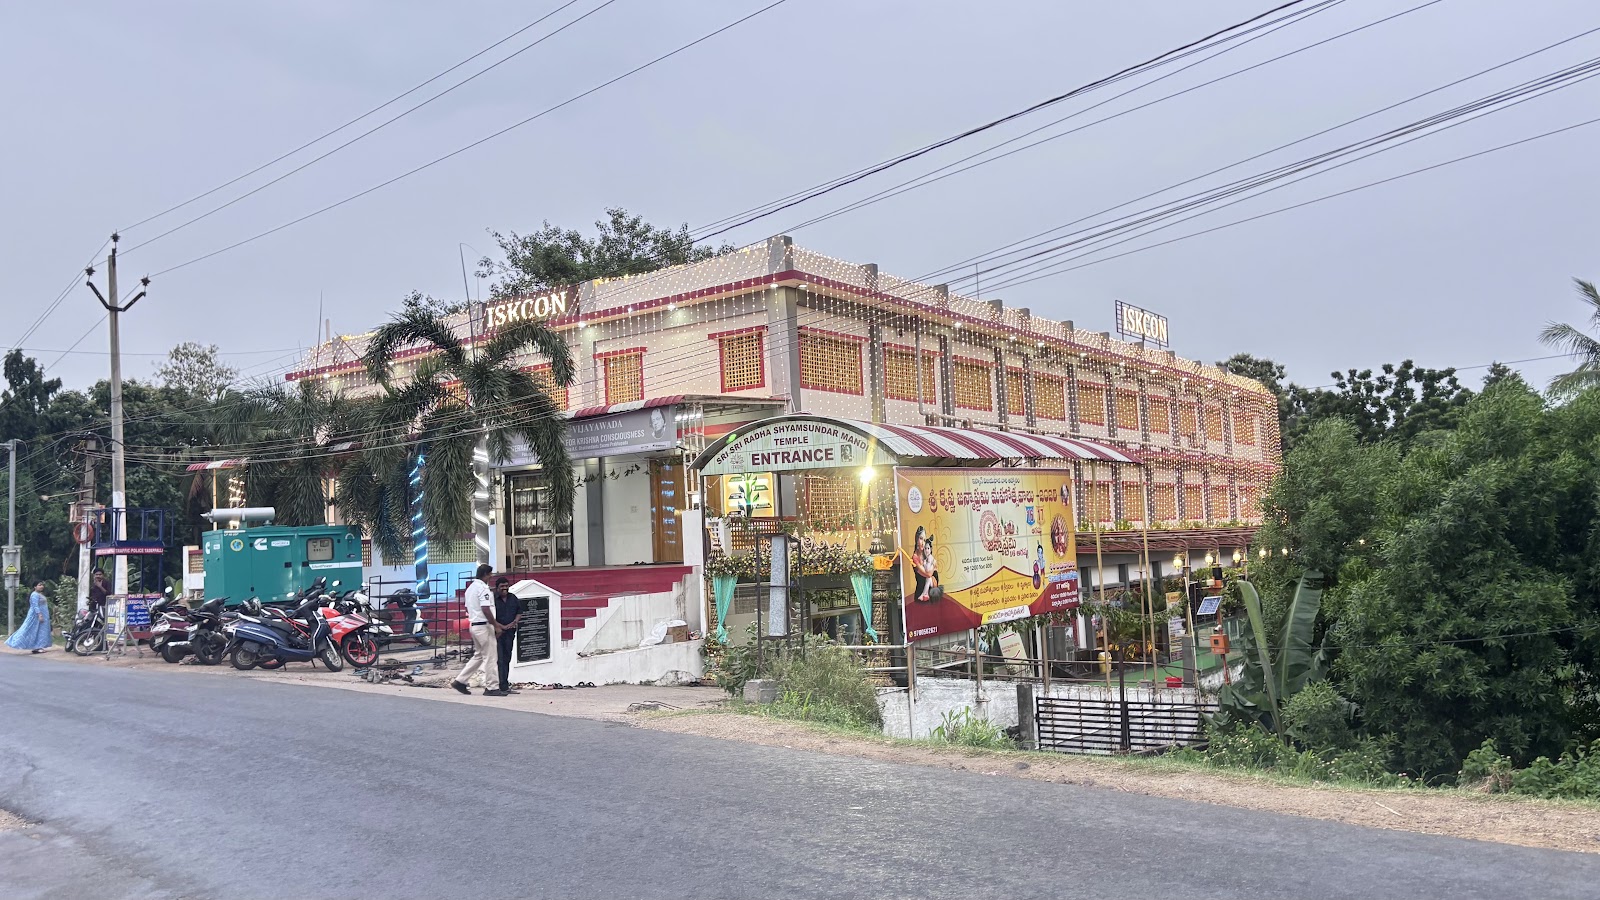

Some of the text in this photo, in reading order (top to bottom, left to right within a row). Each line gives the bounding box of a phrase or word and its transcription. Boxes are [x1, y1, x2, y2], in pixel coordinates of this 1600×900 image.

[486, 291, 567, 328] ISKCON
[1122, 306, 1168, 343] ISKCON
[572, 420, 623, 434] VIJAYAWADA
[565, 429, 645, 448] FOR KRISHNA CONSCIOUSNESS
[716, 451, 729, 465] SRI
[729, 441, 743, 454] SRI
[743, 429, 772, 445] RADHA
[773, 423, 839, 438] SHYAMSUNDAR
[774, 436, 809, 446] TEMPLE
[751, 447, 834, 466] ENTRANCE
[928, 489, 938, 513] శ్రీ
[939, 487, 956, 513] కృష్ణ
[1038, 508, 1044, 522] 17
